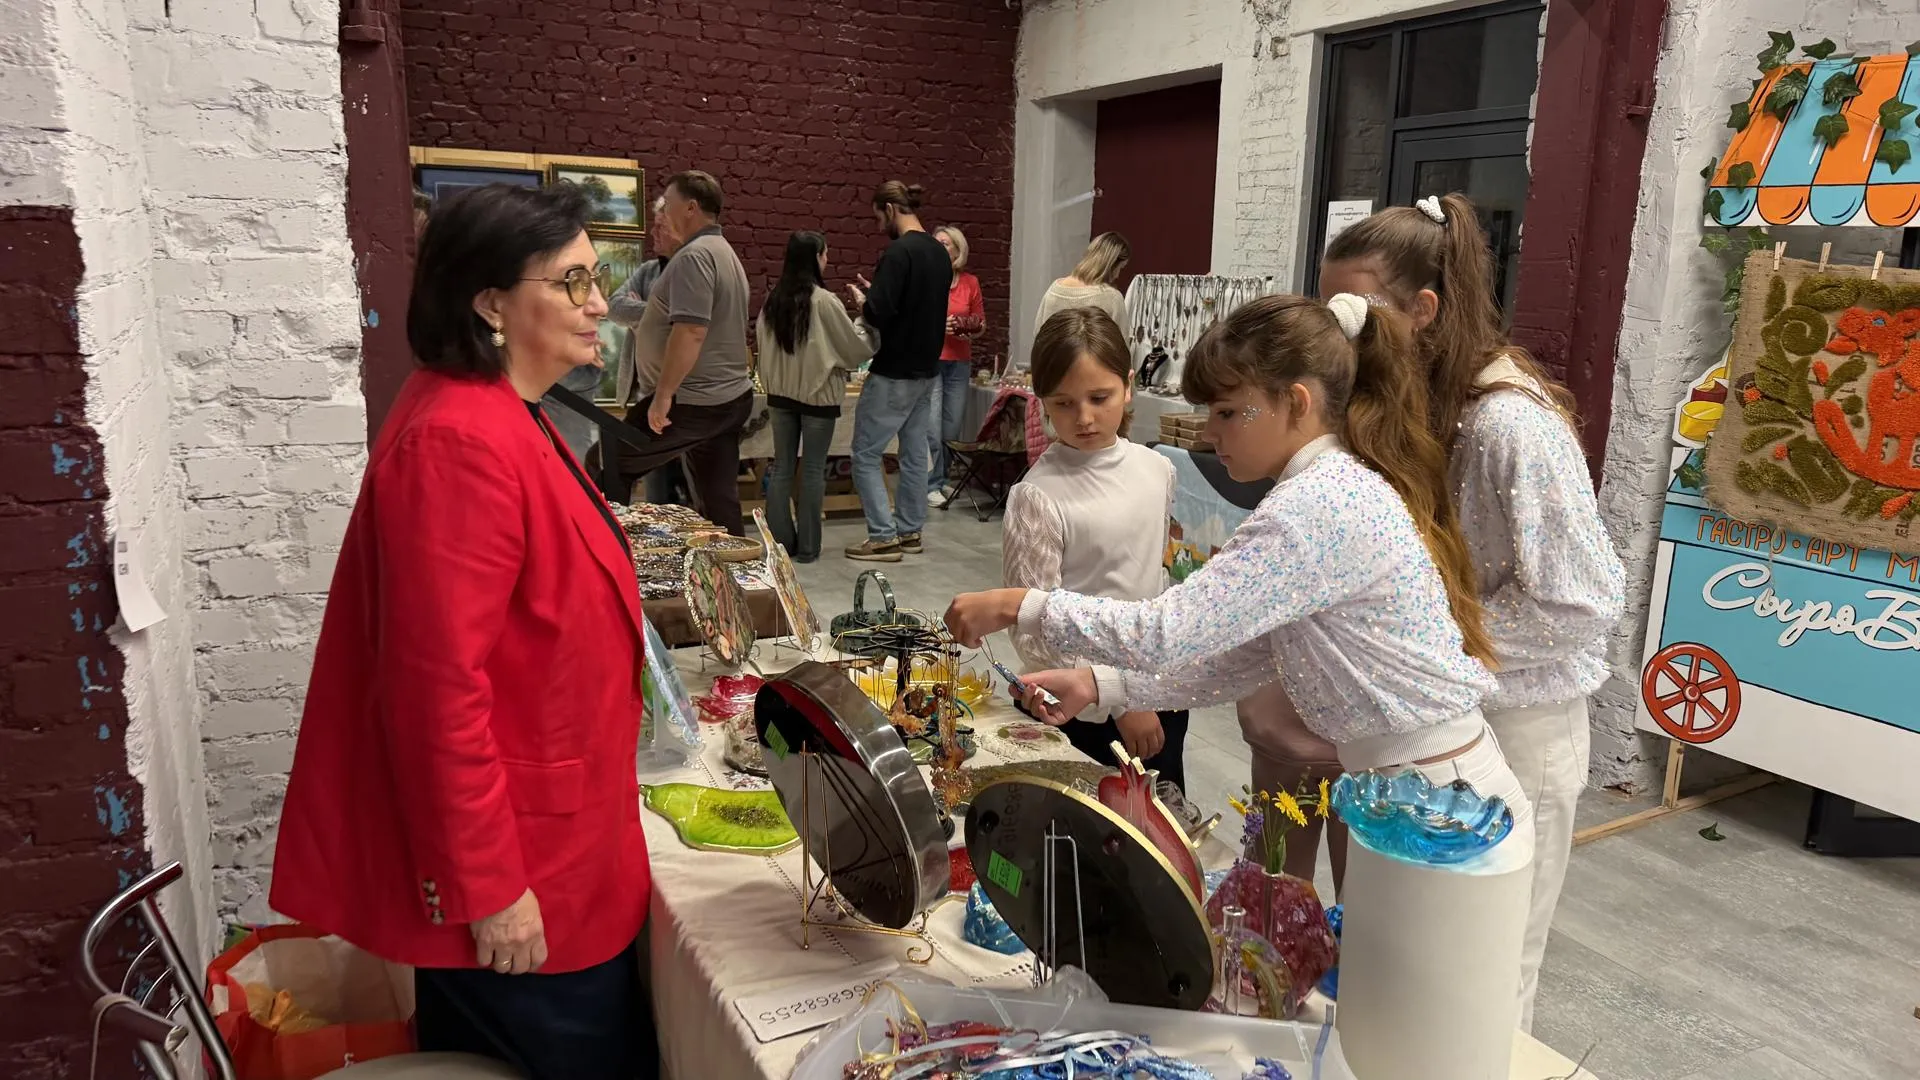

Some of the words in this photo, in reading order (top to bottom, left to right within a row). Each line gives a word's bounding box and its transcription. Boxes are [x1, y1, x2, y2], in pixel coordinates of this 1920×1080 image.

[1696, 514, 1787, 555] ГАСТРО
[1805, 535, 1868, 572] АРТ
[1886, 551, 1920, 584] М
[1702, 562, 1920, 651] СыроВ
